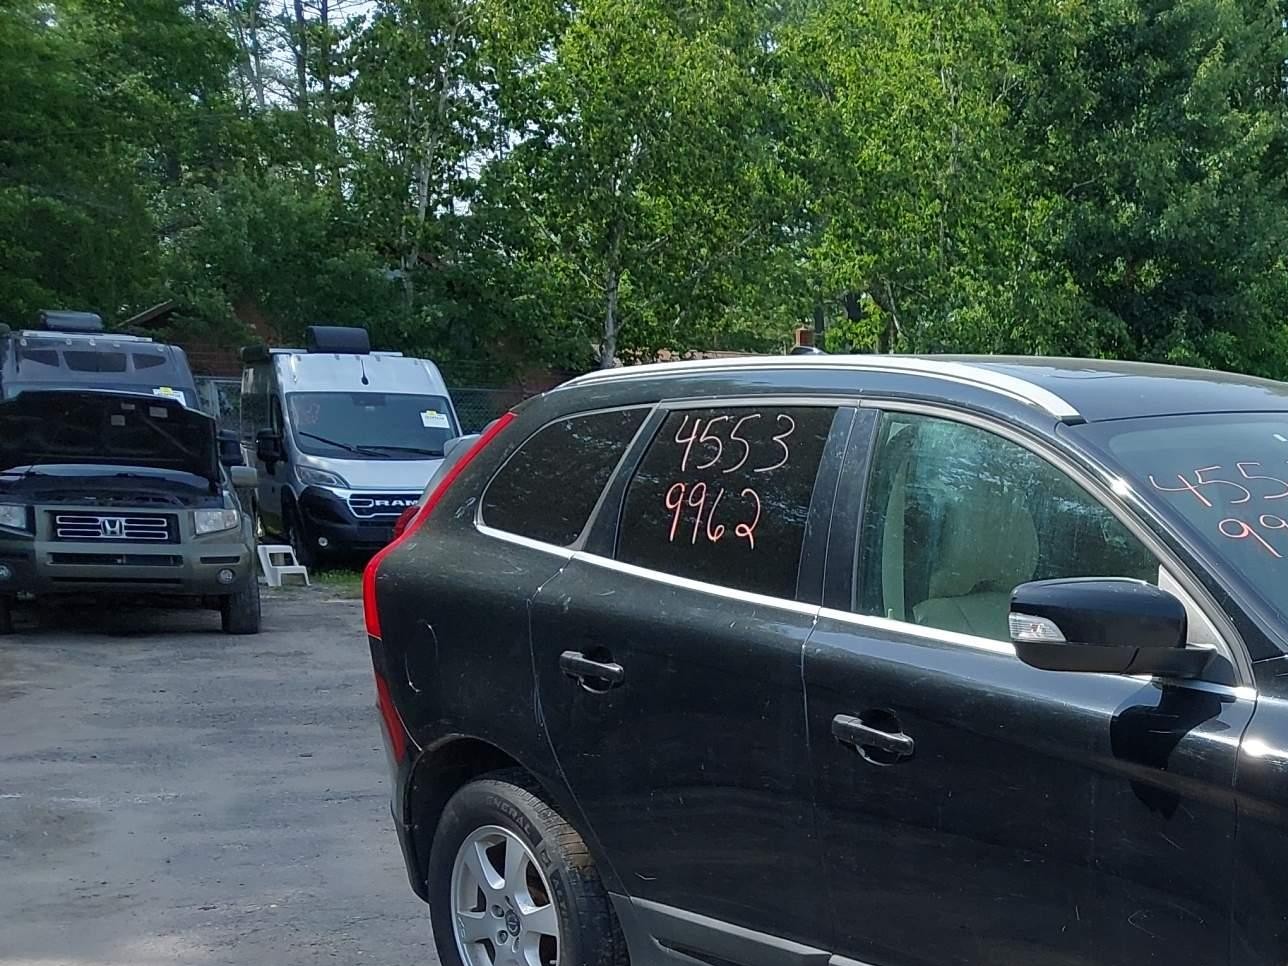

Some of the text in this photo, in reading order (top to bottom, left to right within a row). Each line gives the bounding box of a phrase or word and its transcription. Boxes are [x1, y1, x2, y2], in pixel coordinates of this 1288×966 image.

[675, 414, 796, 473] 4553
[374, 499, 418, 507] RAM
[665, 481, 761, 550] 9962
